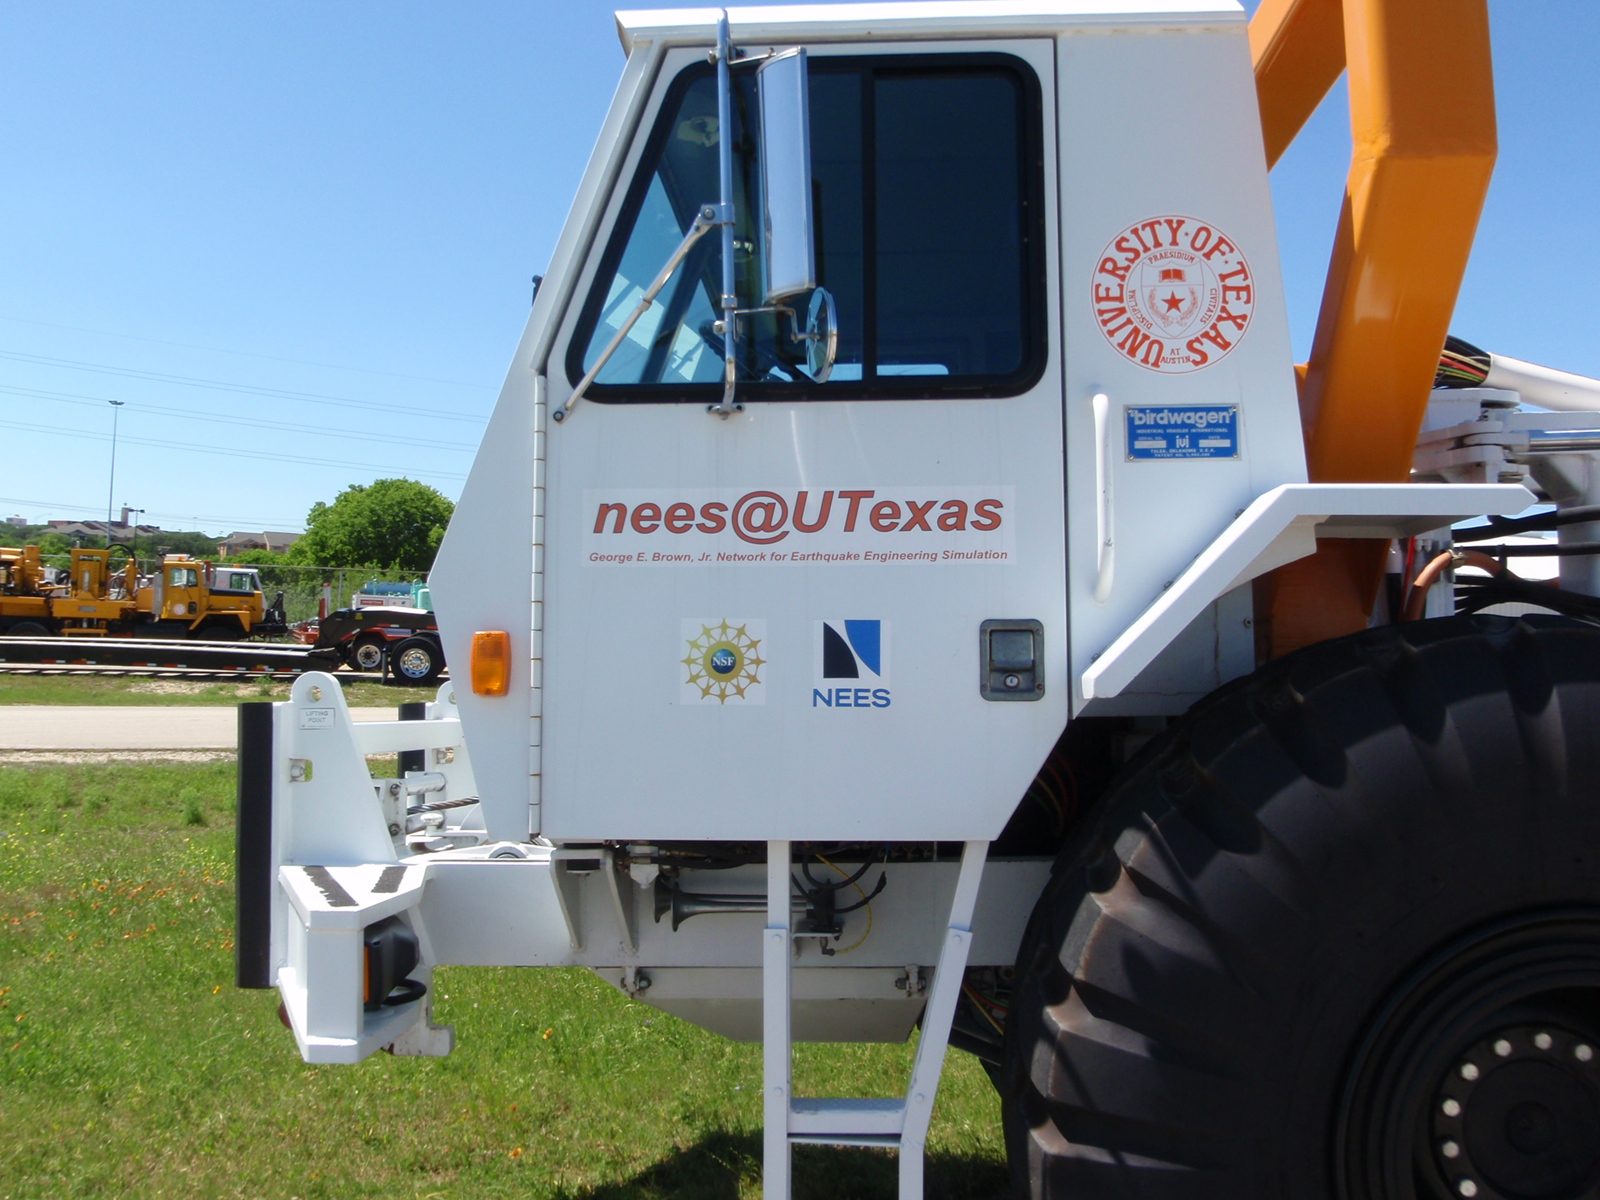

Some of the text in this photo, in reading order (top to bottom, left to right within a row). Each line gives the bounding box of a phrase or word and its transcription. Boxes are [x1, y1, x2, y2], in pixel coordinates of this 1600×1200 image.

[1148, 251, 1196, 265] PRAESIDIUM
[1094, 218, 1251, 368] UNIVERSITY OF TEXAS
[1169, 347, 1181, 356] AT
[1160, 355, 1193, 365] AUSTIN
[593, 489, 1004, 545] nees@UTexas
[589, 550, 1008, 565] George E. Brown, Jr. Network for Earthquake Engineering Simulation
[711, 656, 735, 667] NSF
[812, 688, 892, 708] NEES
